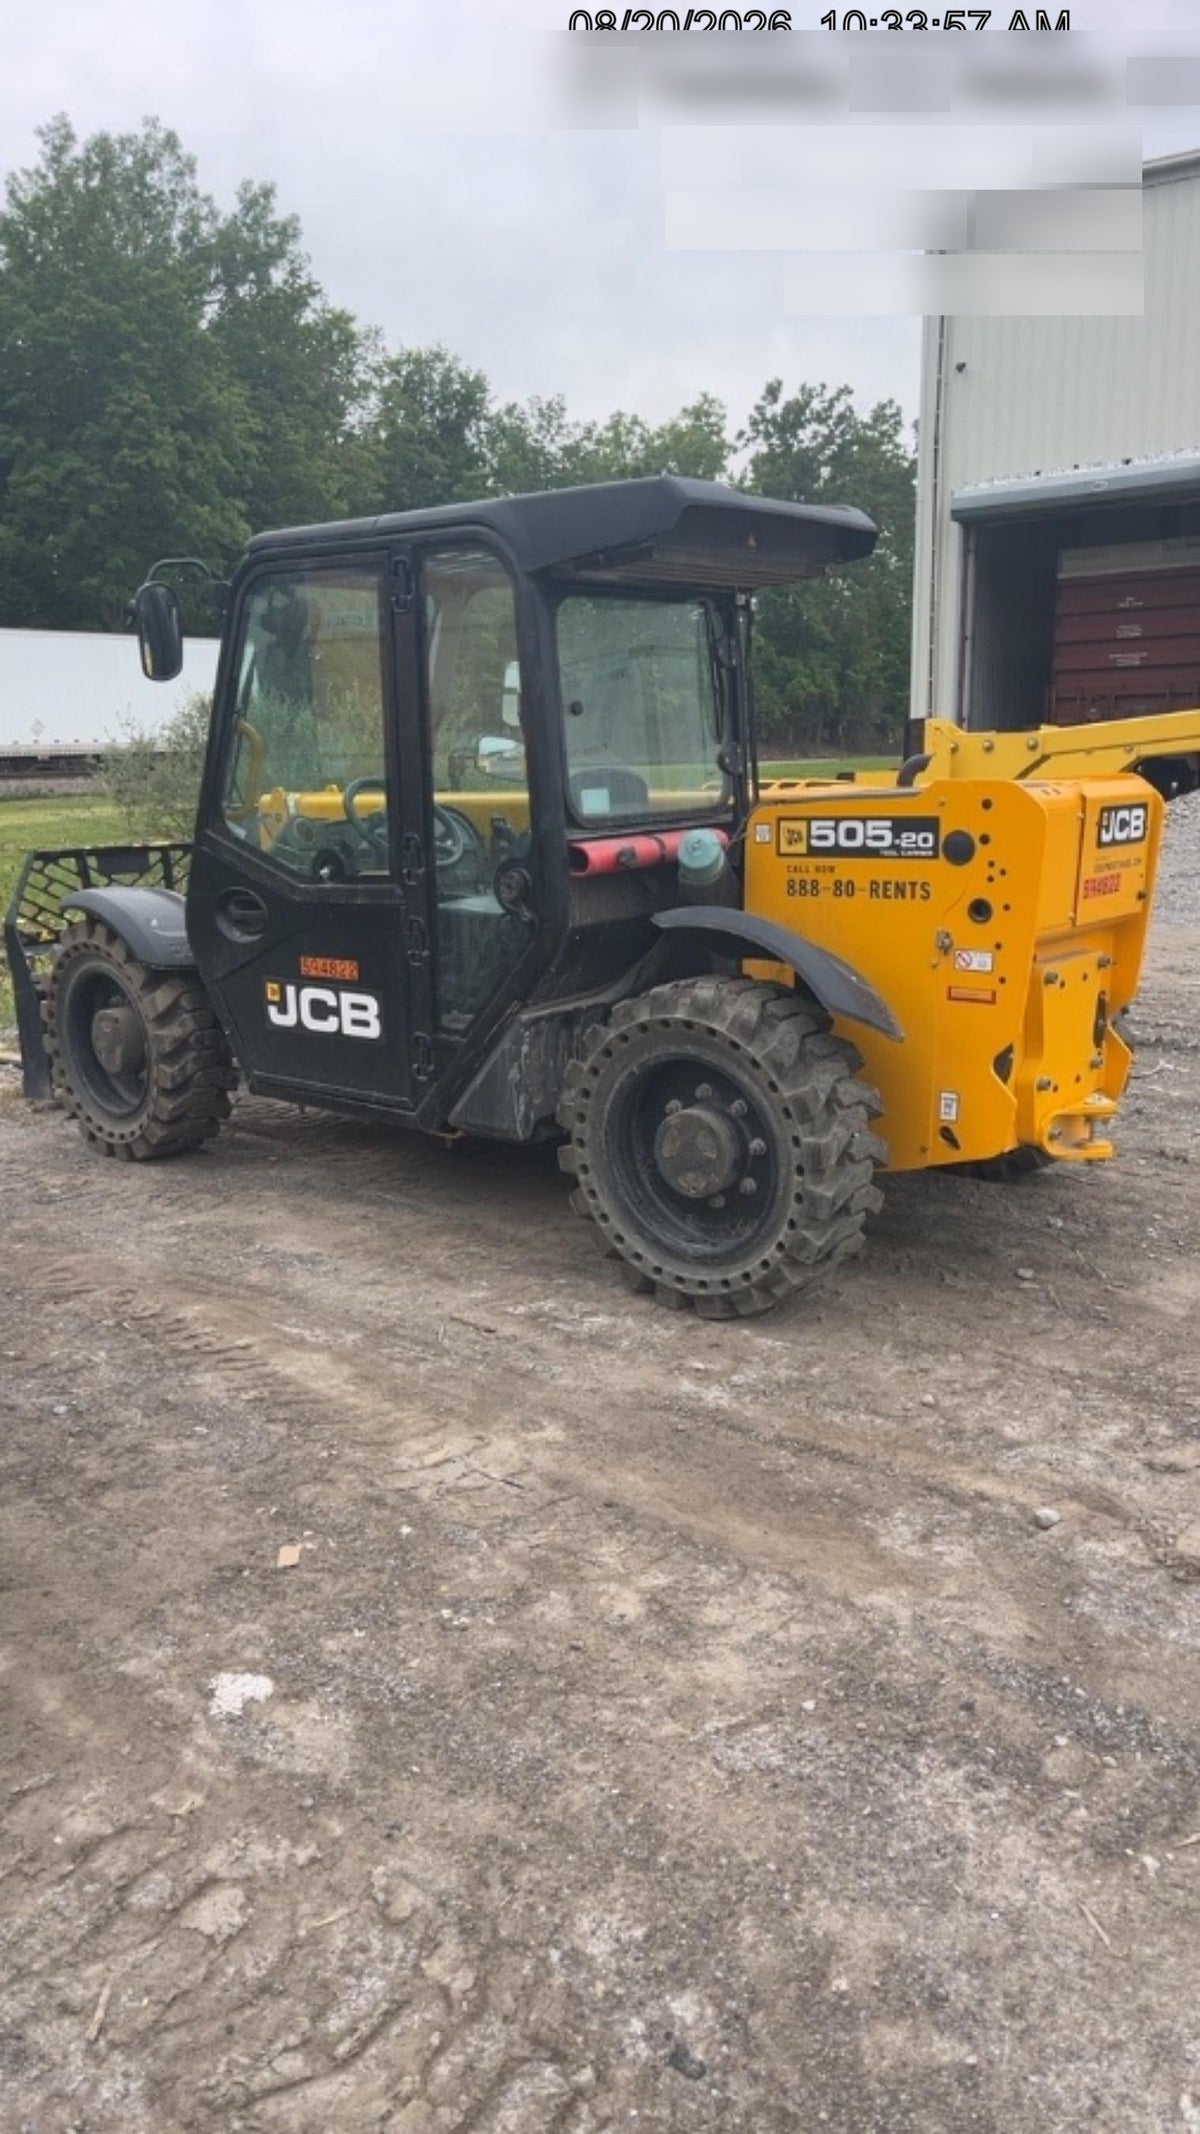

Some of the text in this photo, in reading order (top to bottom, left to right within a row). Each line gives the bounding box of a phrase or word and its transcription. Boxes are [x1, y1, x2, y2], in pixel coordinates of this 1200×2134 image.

[1102, 808, 1145, 843] JCB
[786, 865, 836, 873] CALL NOW
[786, 879, 931, 900] 888-80-RENTS
[267, 984, 381, 1039] JCB
